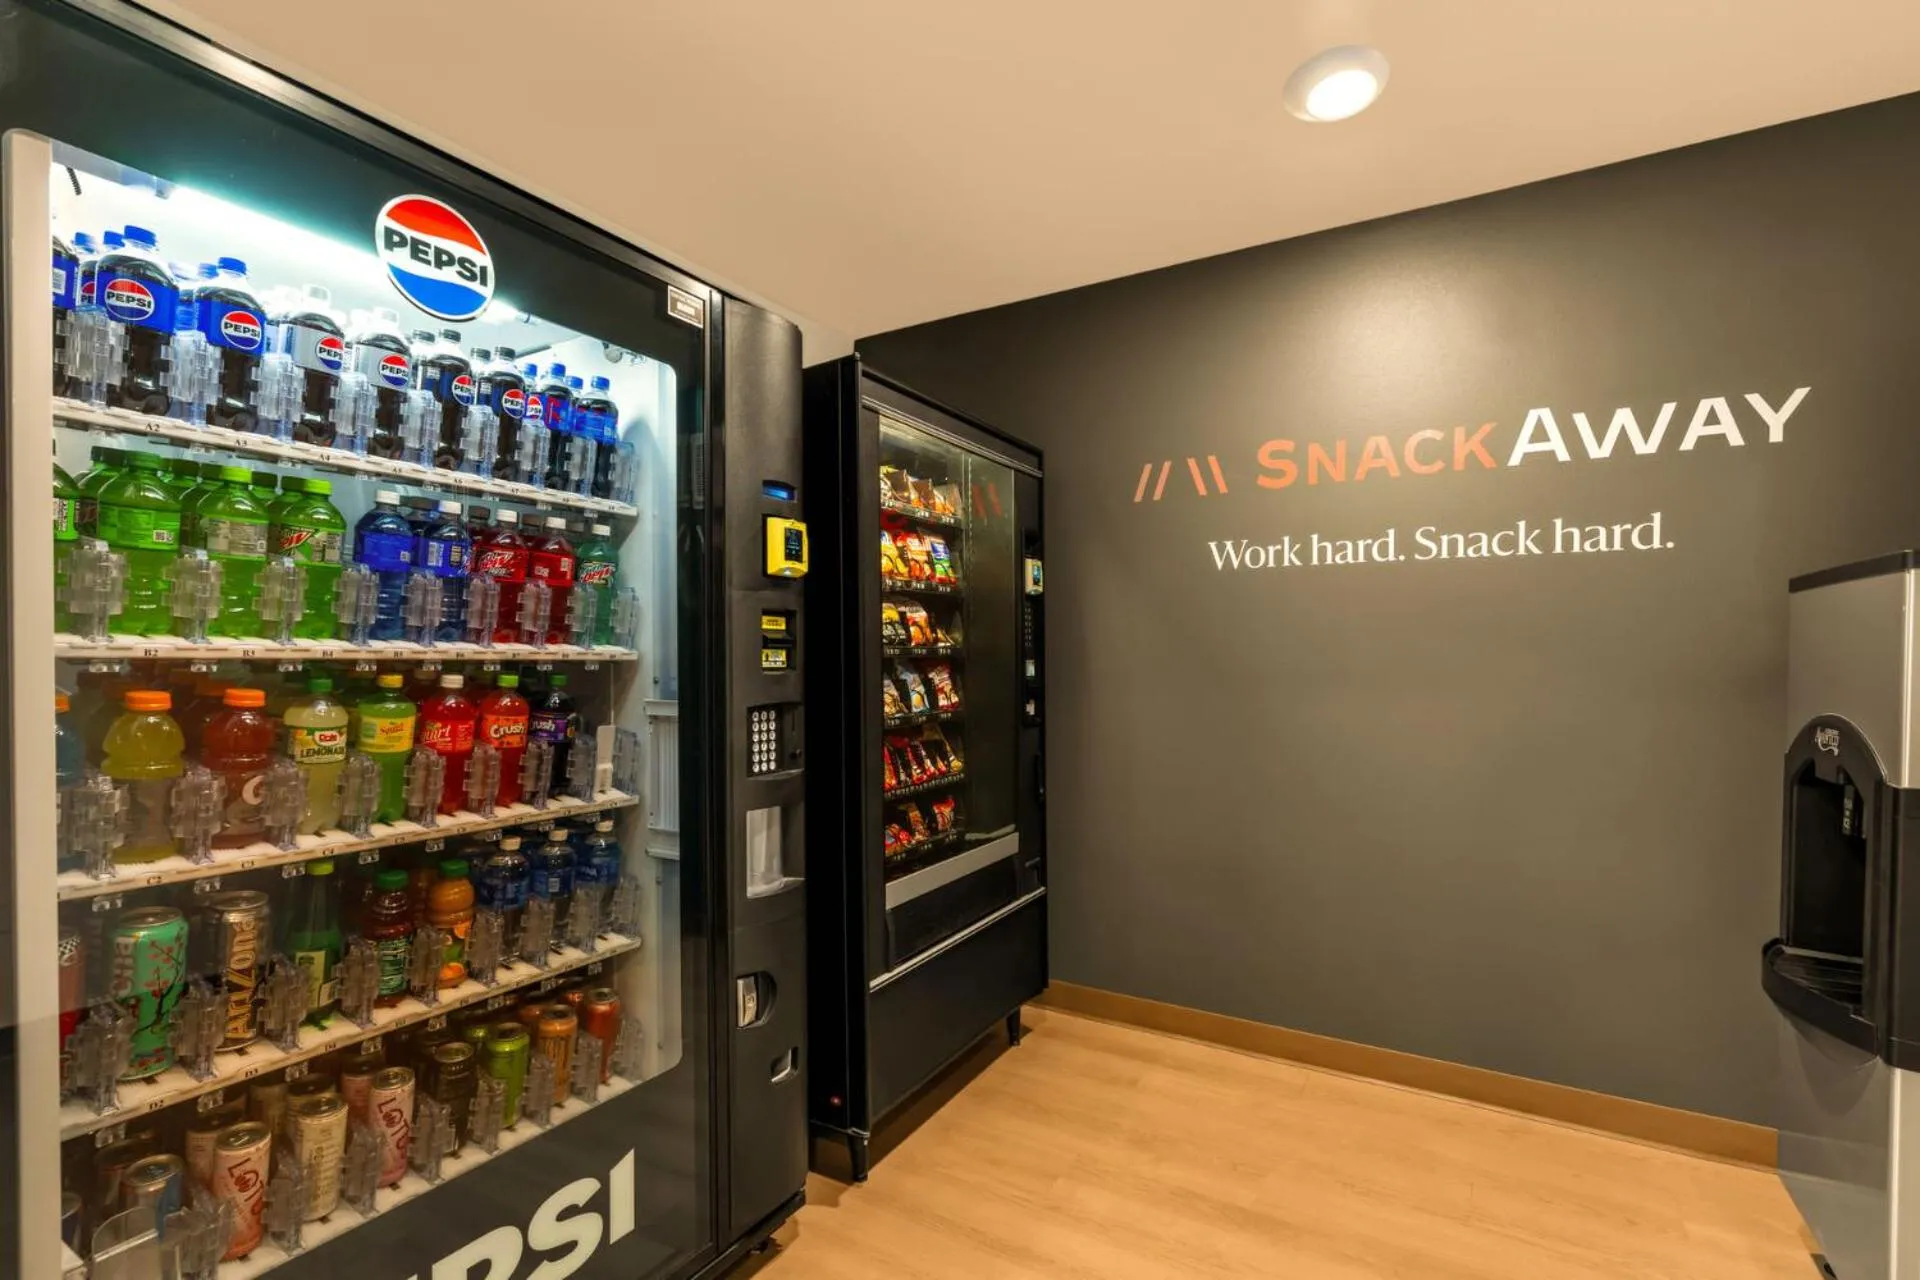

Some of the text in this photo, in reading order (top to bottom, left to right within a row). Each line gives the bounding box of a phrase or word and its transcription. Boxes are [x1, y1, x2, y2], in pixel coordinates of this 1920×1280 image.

[384, 225, 487, 288] PEPSI
[106, 290, 153, 310] PEPSI
[224, 321, 260, 338] PEPSI
[382, 364, 408, 378] PEPS
[145, 422, 160, 432] A2
[1208, 511, 1675, 571] Work hard. Snack hard.
[144, 648, 158, 657] B2
[489, 722, 524, 739] Crush
[532, 719, 555, 732] rush
